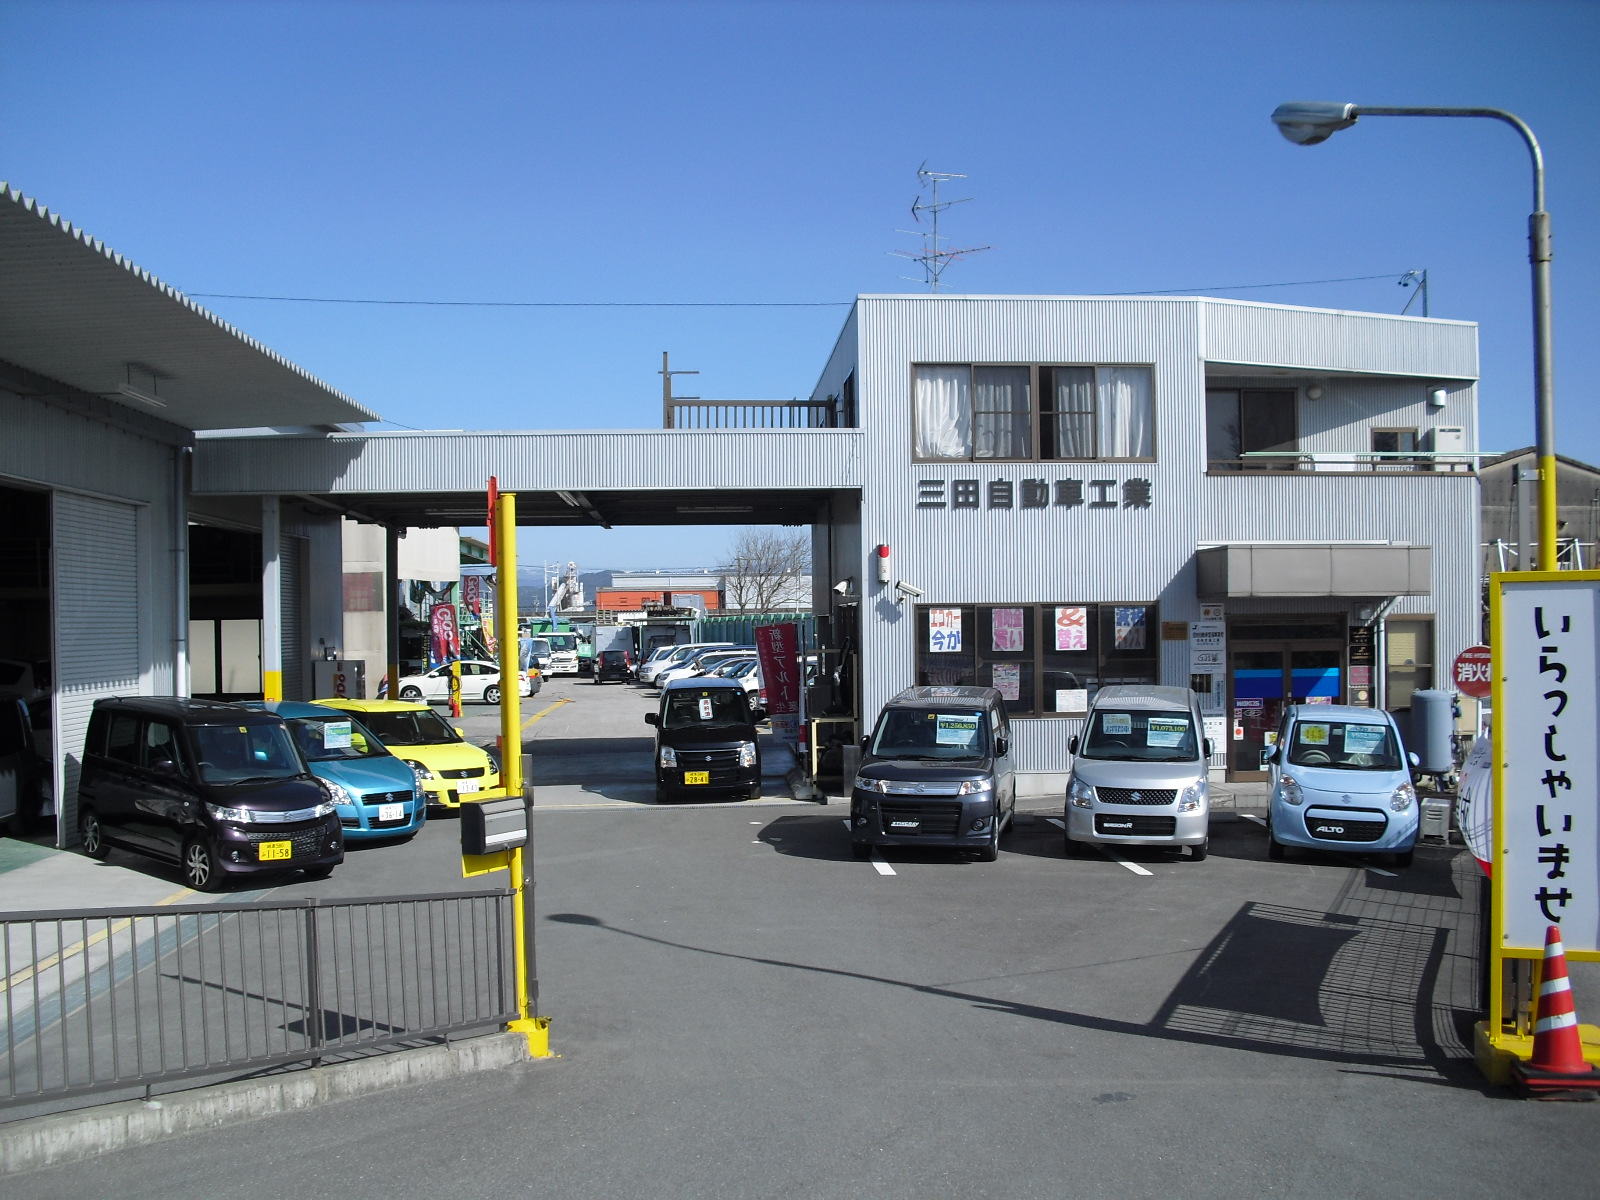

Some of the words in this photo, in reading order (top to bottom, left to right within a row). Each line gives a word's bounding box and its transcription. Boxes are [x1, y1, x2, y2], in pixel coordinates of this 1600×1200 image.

[916, 478, 1152, 511] 三田自動車工業
[931, 609, 960, 628] エコカー
[1057, 608, 1085, 627] &
[932, 630, 960, 650] 今が
[994, 629, 1023, 650] 買い
[1058, 629, 1085, 649] 替え
[1534, 606, 1572, 923] いらっしゃいませ
[1315, 825, 1344, 834] ALTO
[267, 848, 289, 859] 11-58
